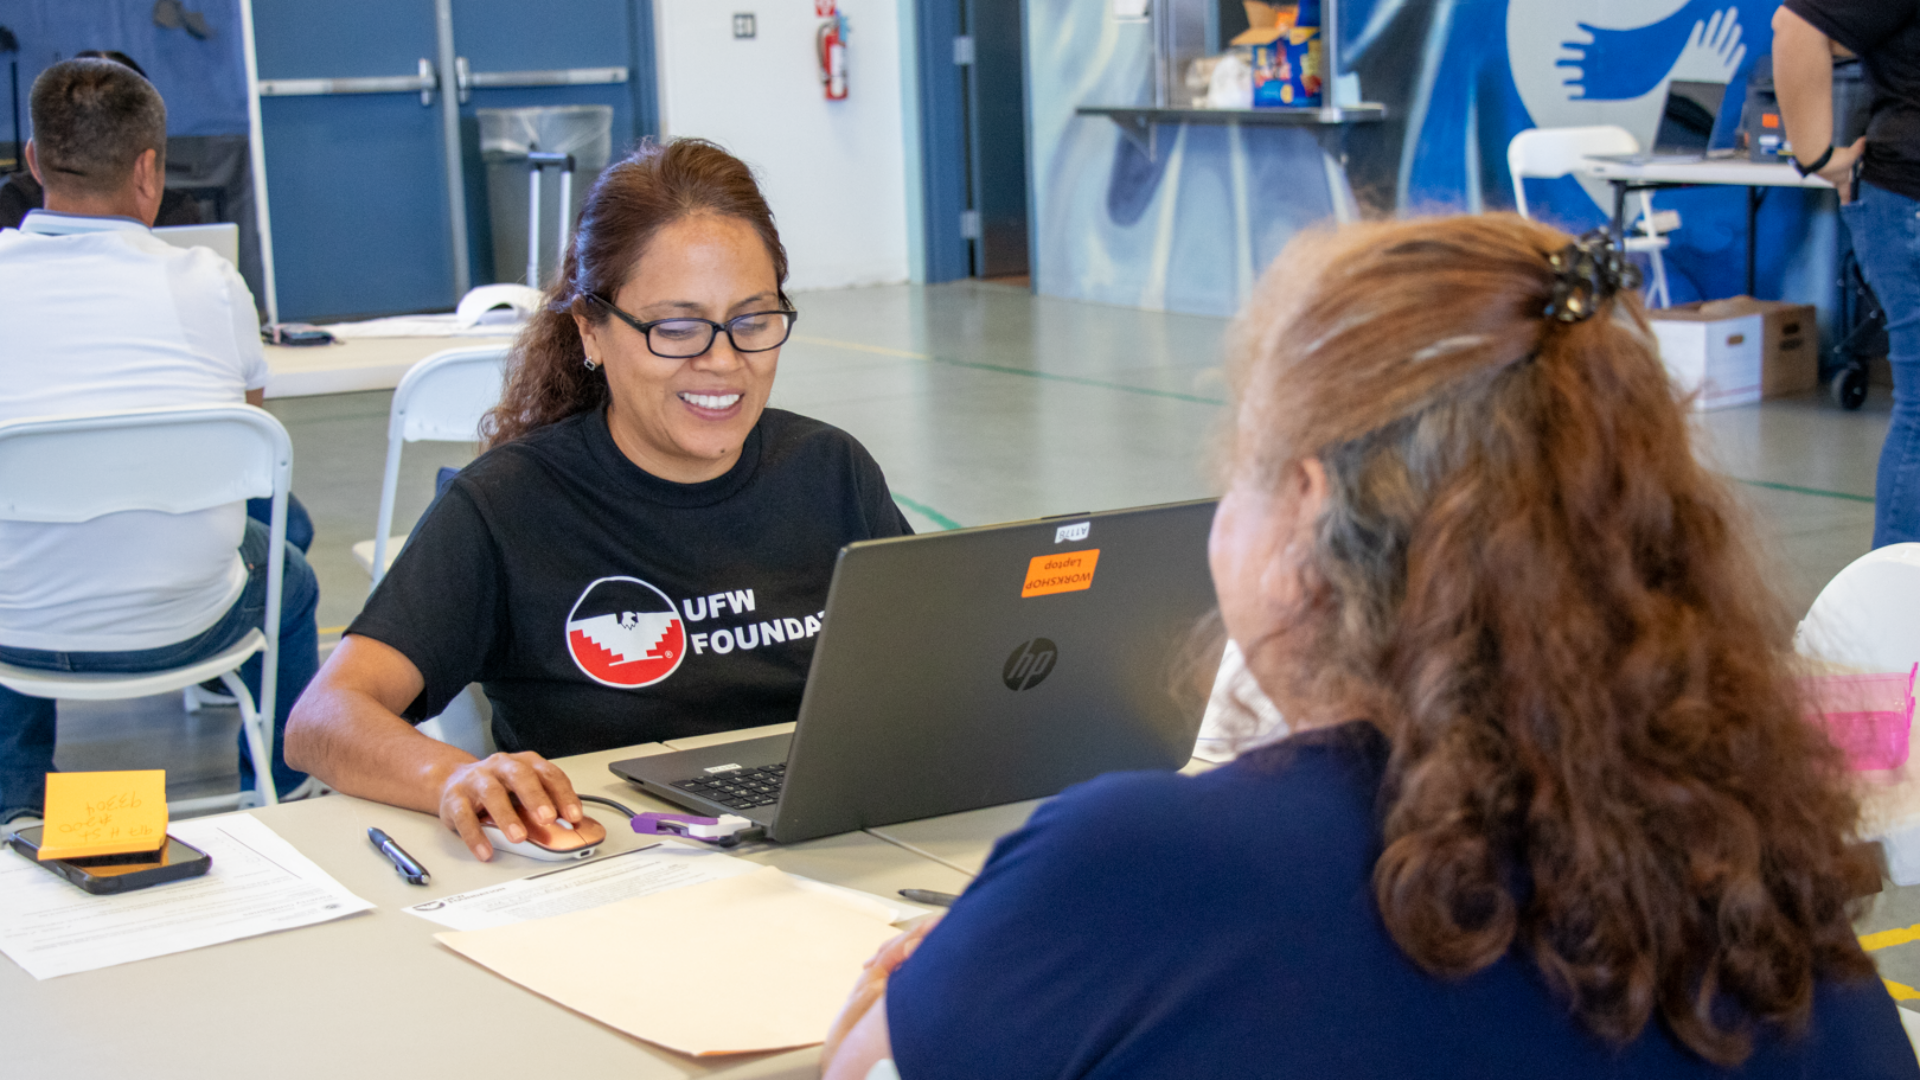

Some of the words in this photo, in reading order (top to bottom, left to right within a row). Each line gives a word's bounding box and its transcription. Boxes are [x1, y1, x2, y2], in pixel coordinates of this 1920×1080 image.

[1044, 557, 1082, 571] Laptop
[1025, 572, 1091, 590] WORKSHOP
[683, 588, 756, 622] UFW
[690, 610, 826, 655] FOUNDA
[1003, 637, 1057, 691] hp
[128, 824, 153, 837] 917
